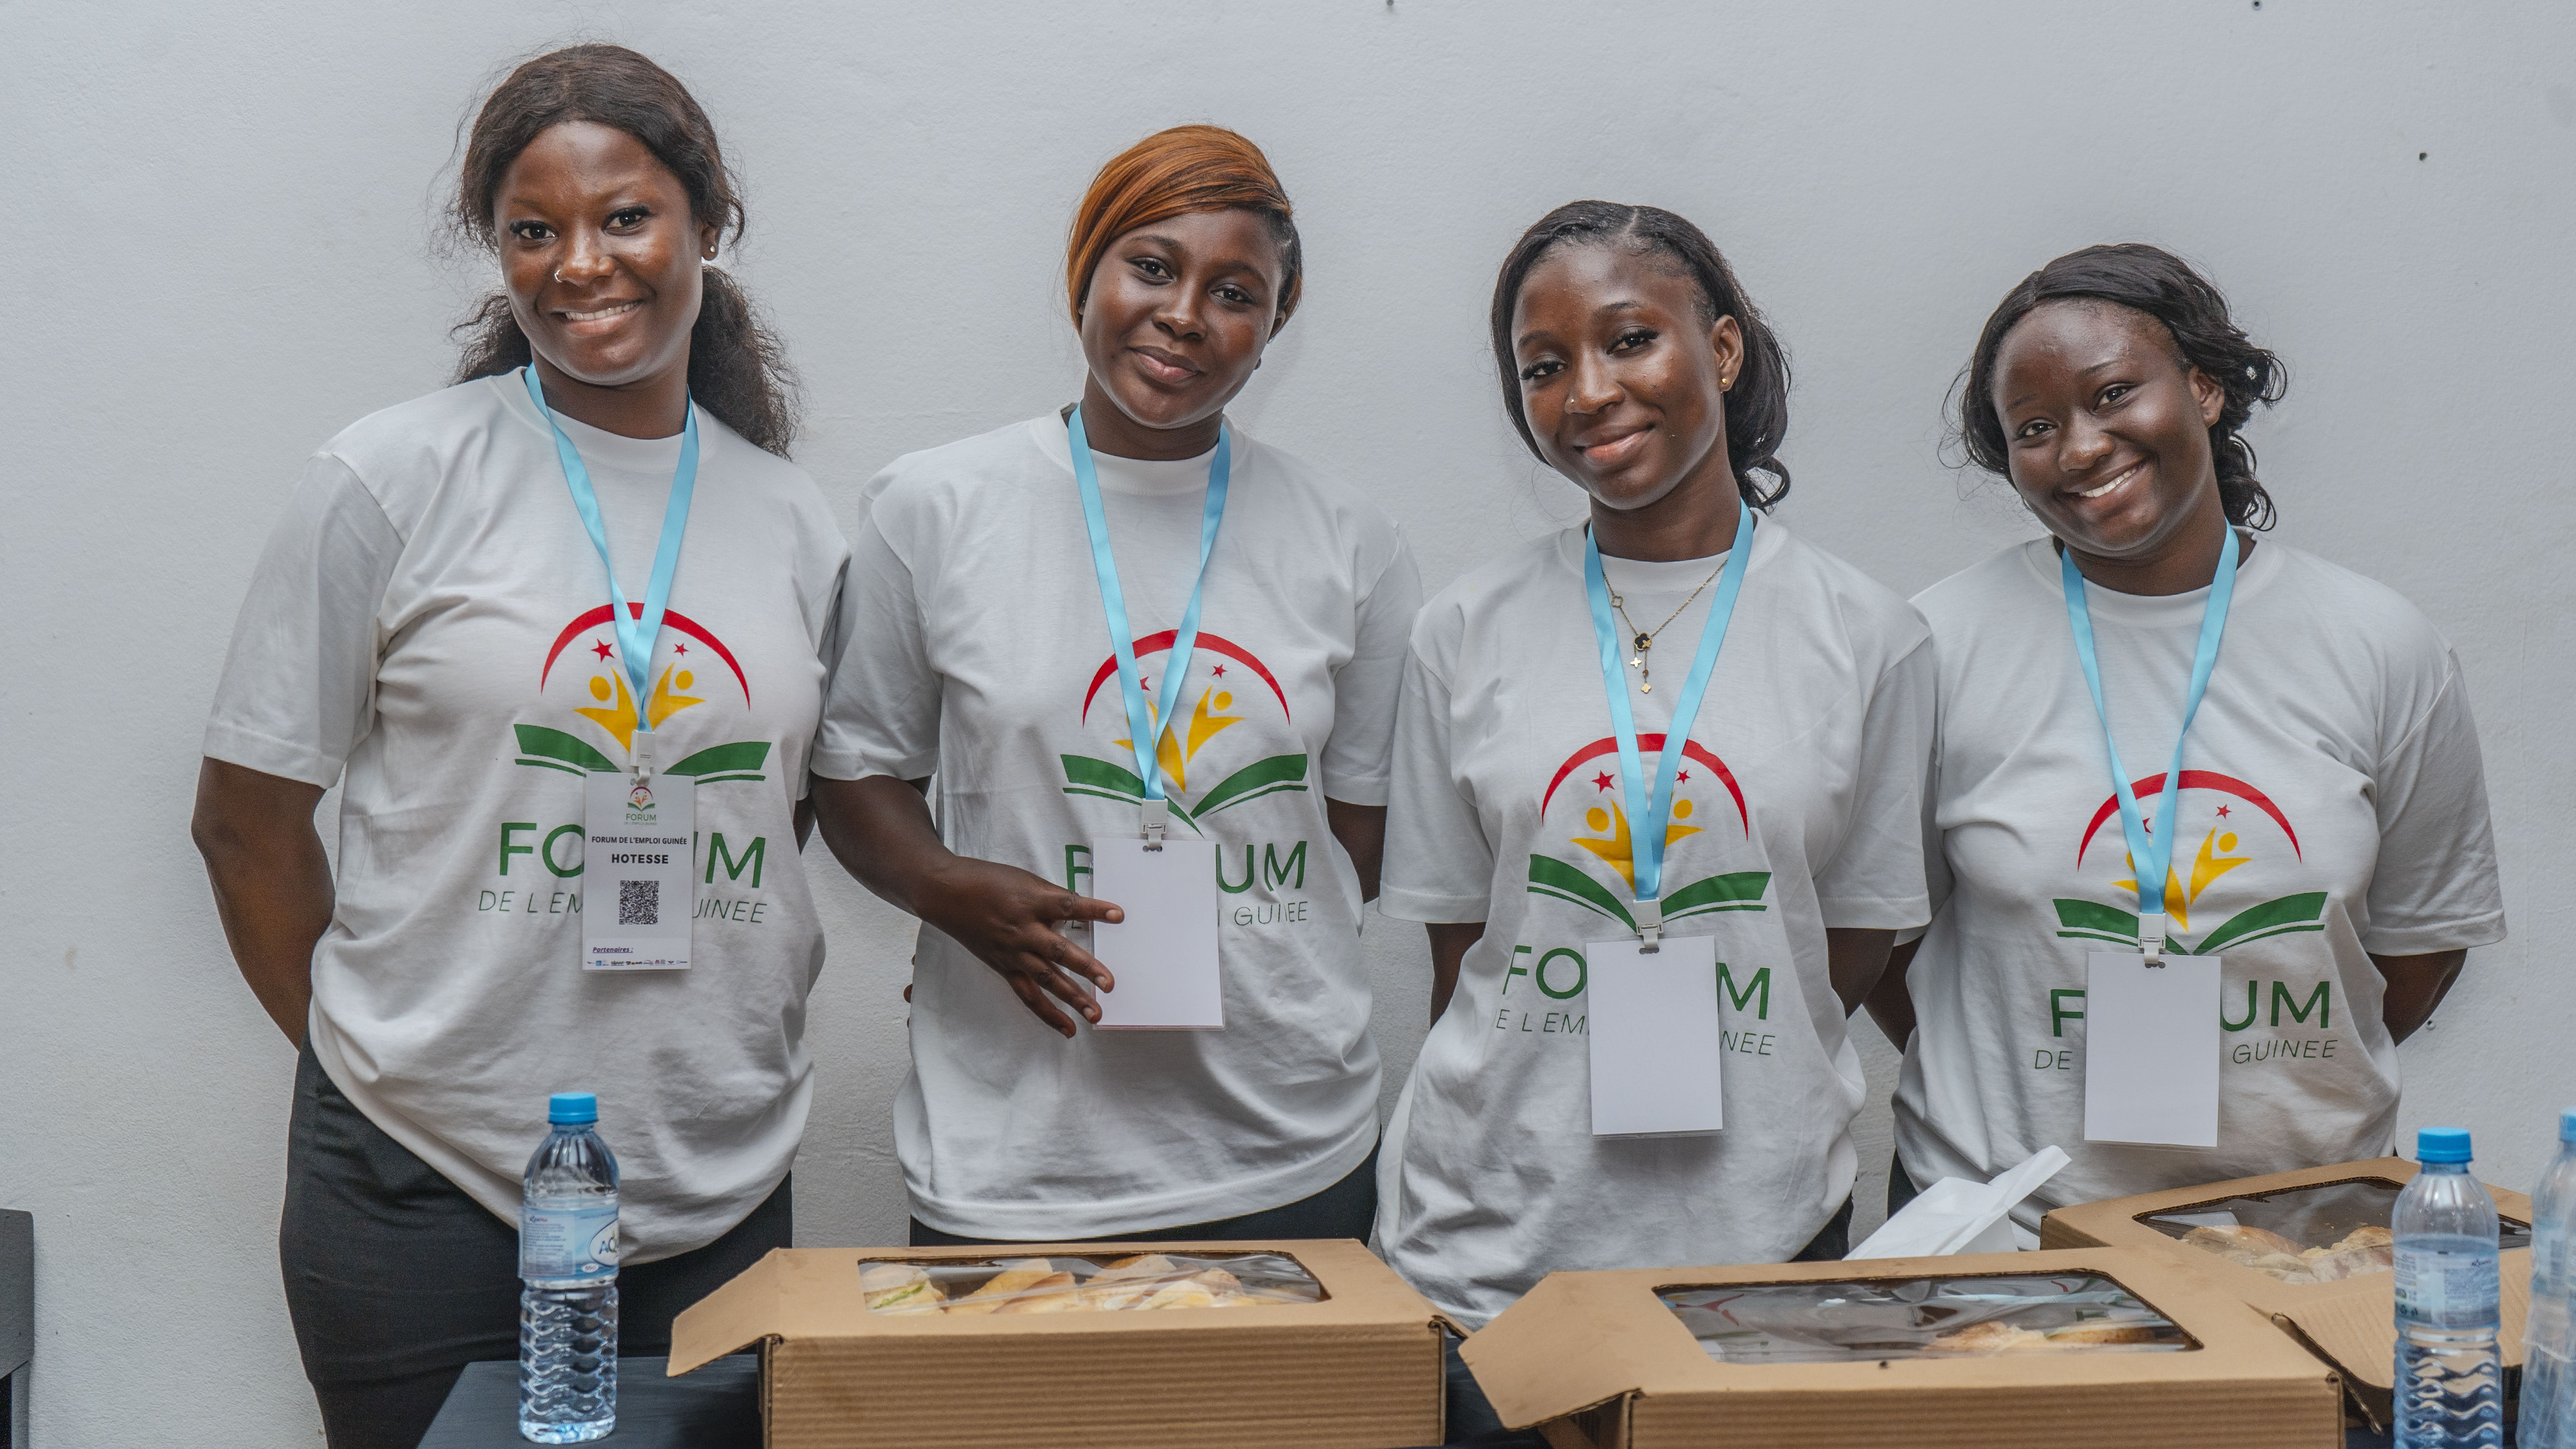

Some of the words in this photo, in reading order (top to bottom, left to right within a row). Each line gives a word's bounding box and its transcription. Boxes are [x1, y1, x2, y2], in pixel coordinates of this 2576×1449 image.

[626, 813, 656, 822] FORUM
[500, 822, 766, 888] FOM
[611, 854, 669, 864] HOTESSE
[1065, 840, 1307, 893] FUM
[479, 890, 515, 911] DE
[693, 899, 767, 923] UINEE
[1503, 945, 1770, 1020] FOM
[2050, 980, 2330, 1037] FUM
[2035, 1049, 2072, 1070] DE
[2233, 1040, 2338, 1064] GUINEE
